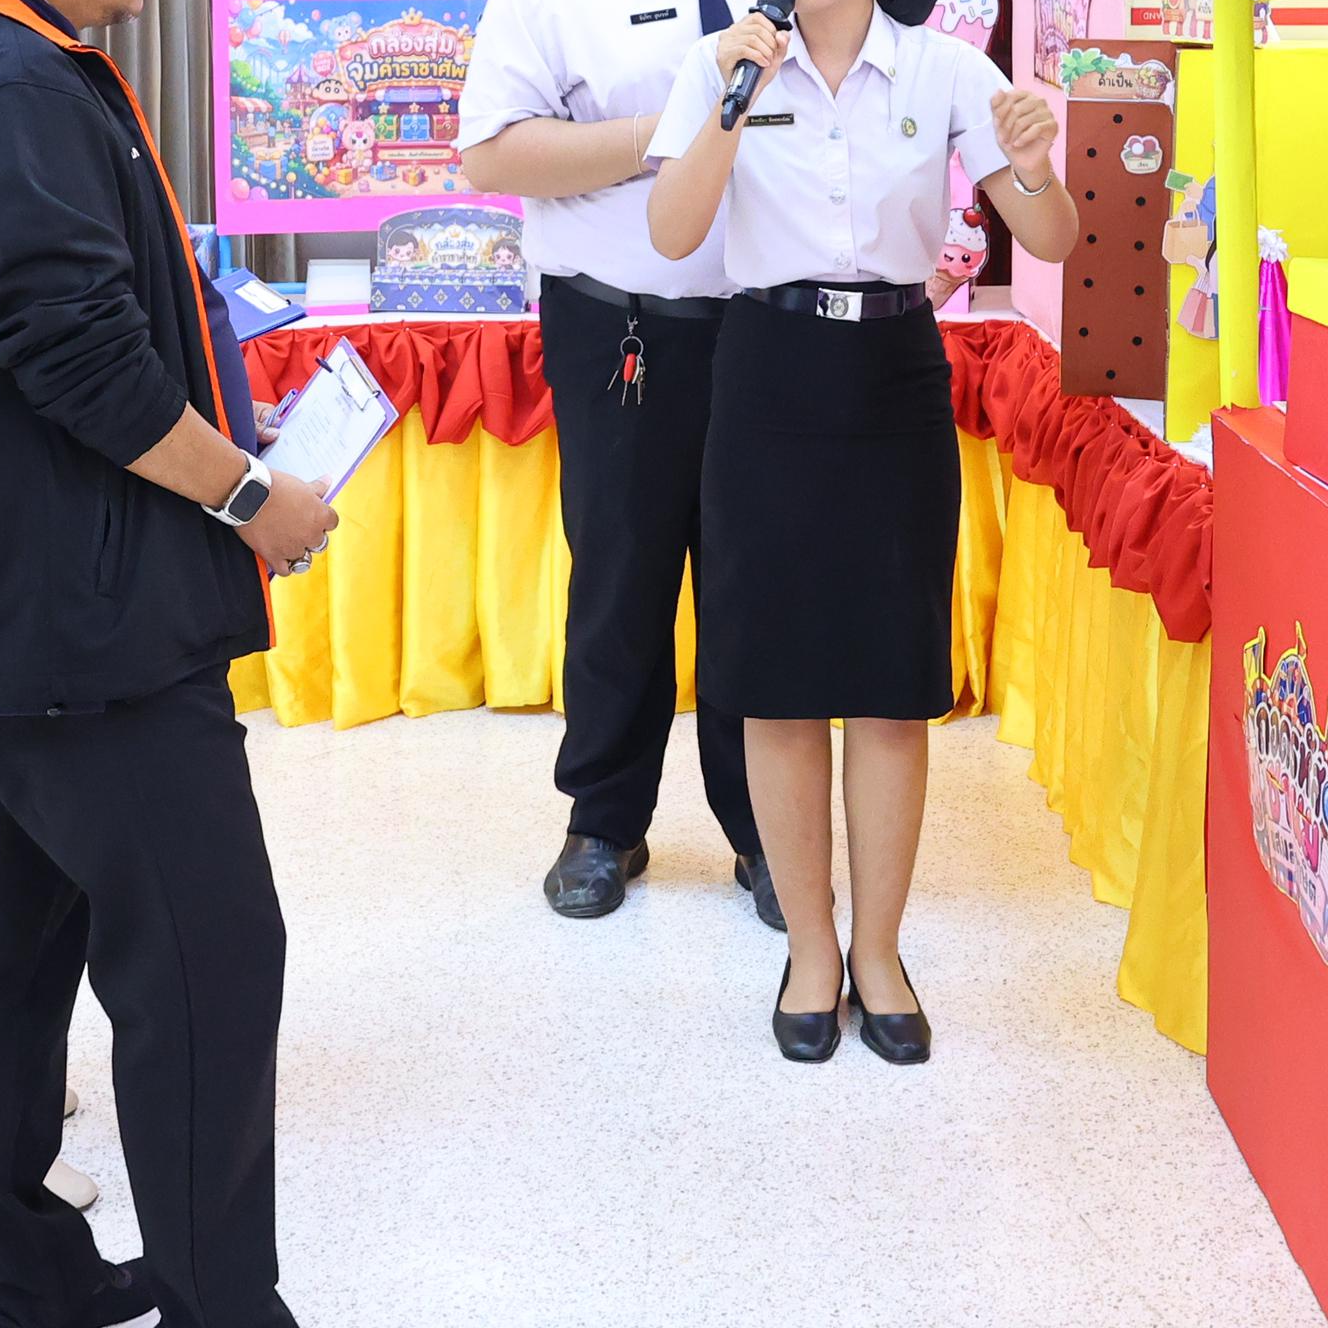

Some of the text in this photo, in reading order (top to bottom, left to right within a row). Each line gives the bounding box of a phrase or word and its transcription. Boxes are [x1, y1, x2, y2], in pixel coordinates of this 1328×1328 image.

[370, 30, 456, 58] กล่องสุ่ม
[347, 53, 467, 90] จุ่มคำราชาศัพ
